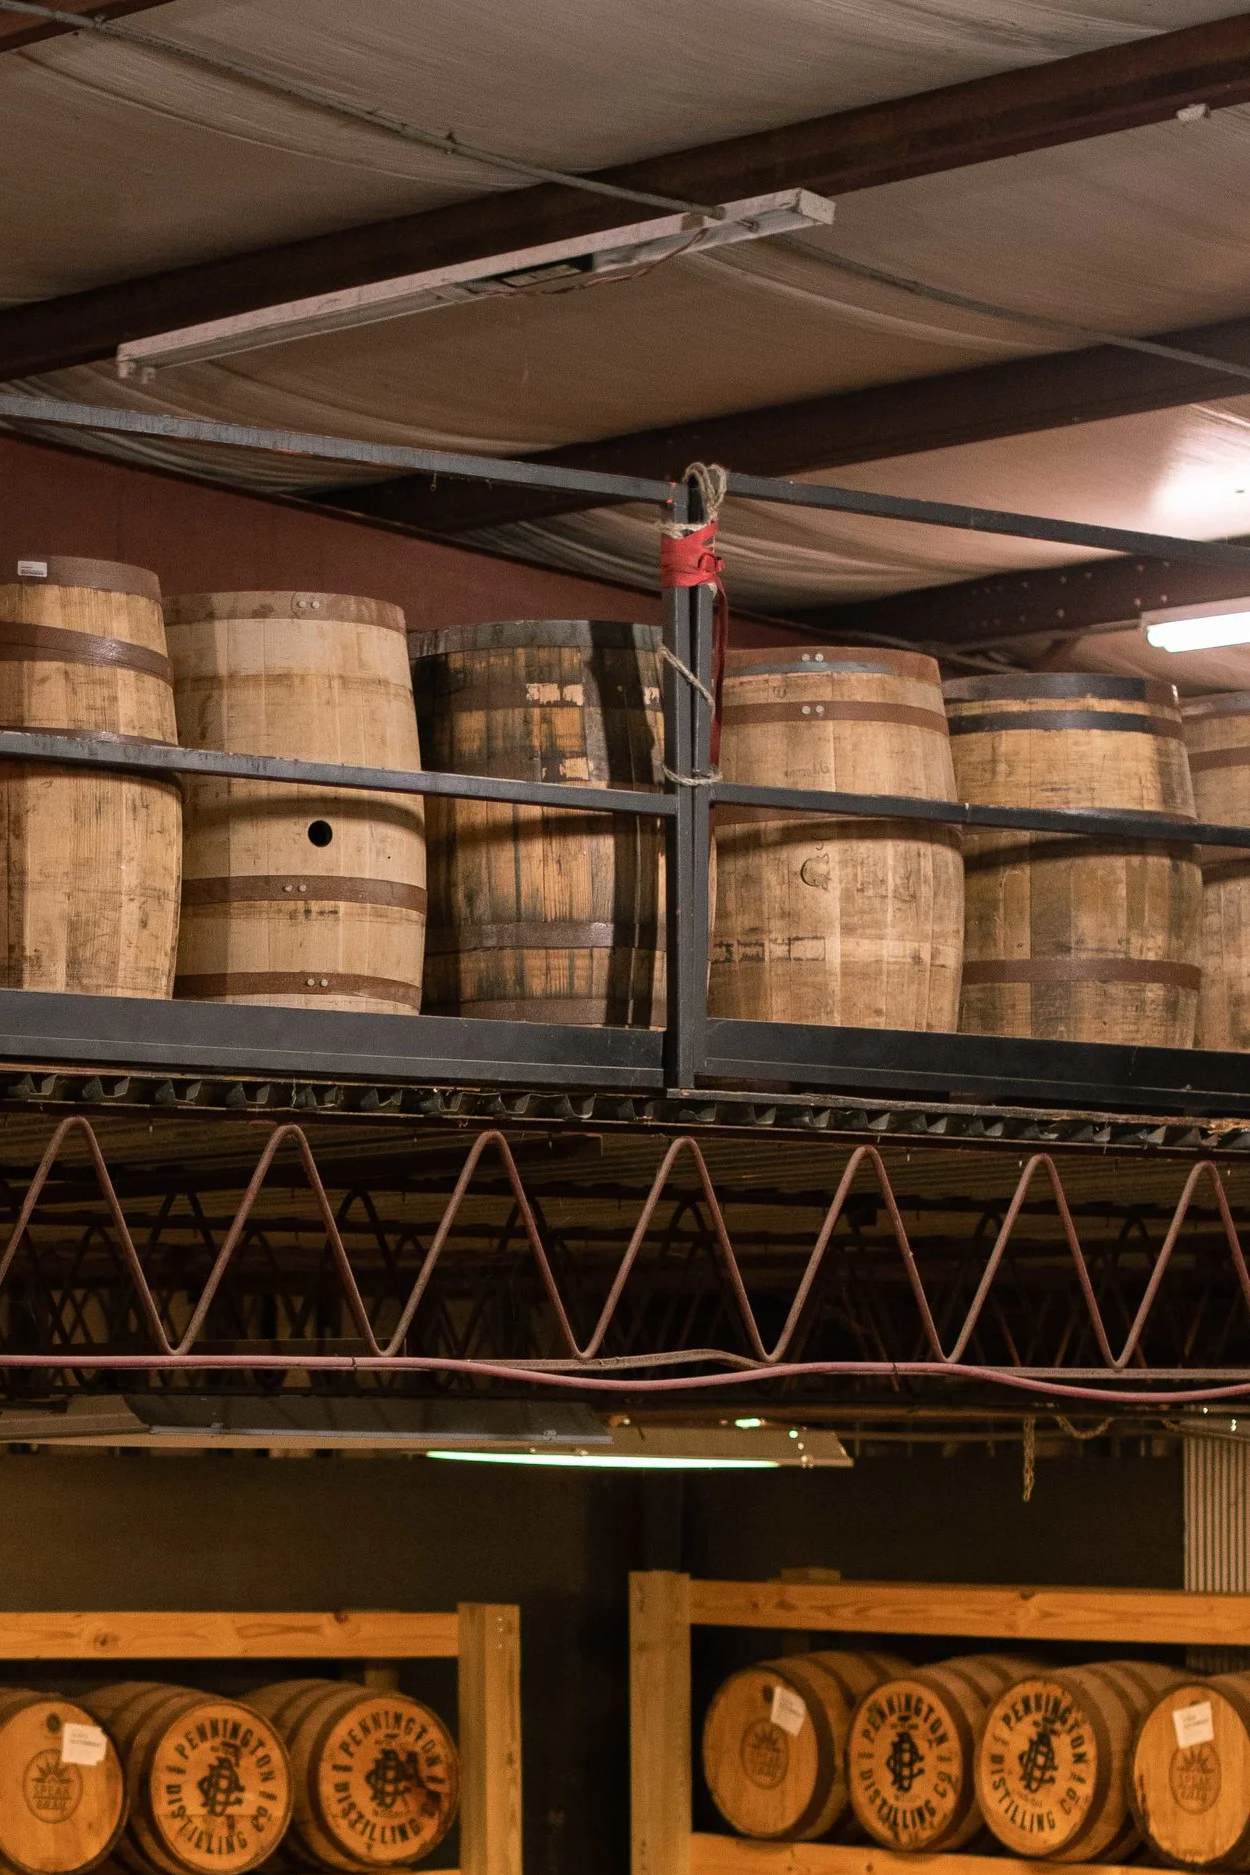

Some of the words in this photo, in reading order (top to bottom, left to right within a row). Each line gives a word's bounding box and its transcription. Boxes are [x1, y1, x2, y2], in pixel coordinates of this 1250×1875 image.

[175, 1718, 276, 1784] PENNINGTON
[338, 1710, 442, 1769] PENNINGTON
[989, 1753, 1057, 1834] DISTILLING
